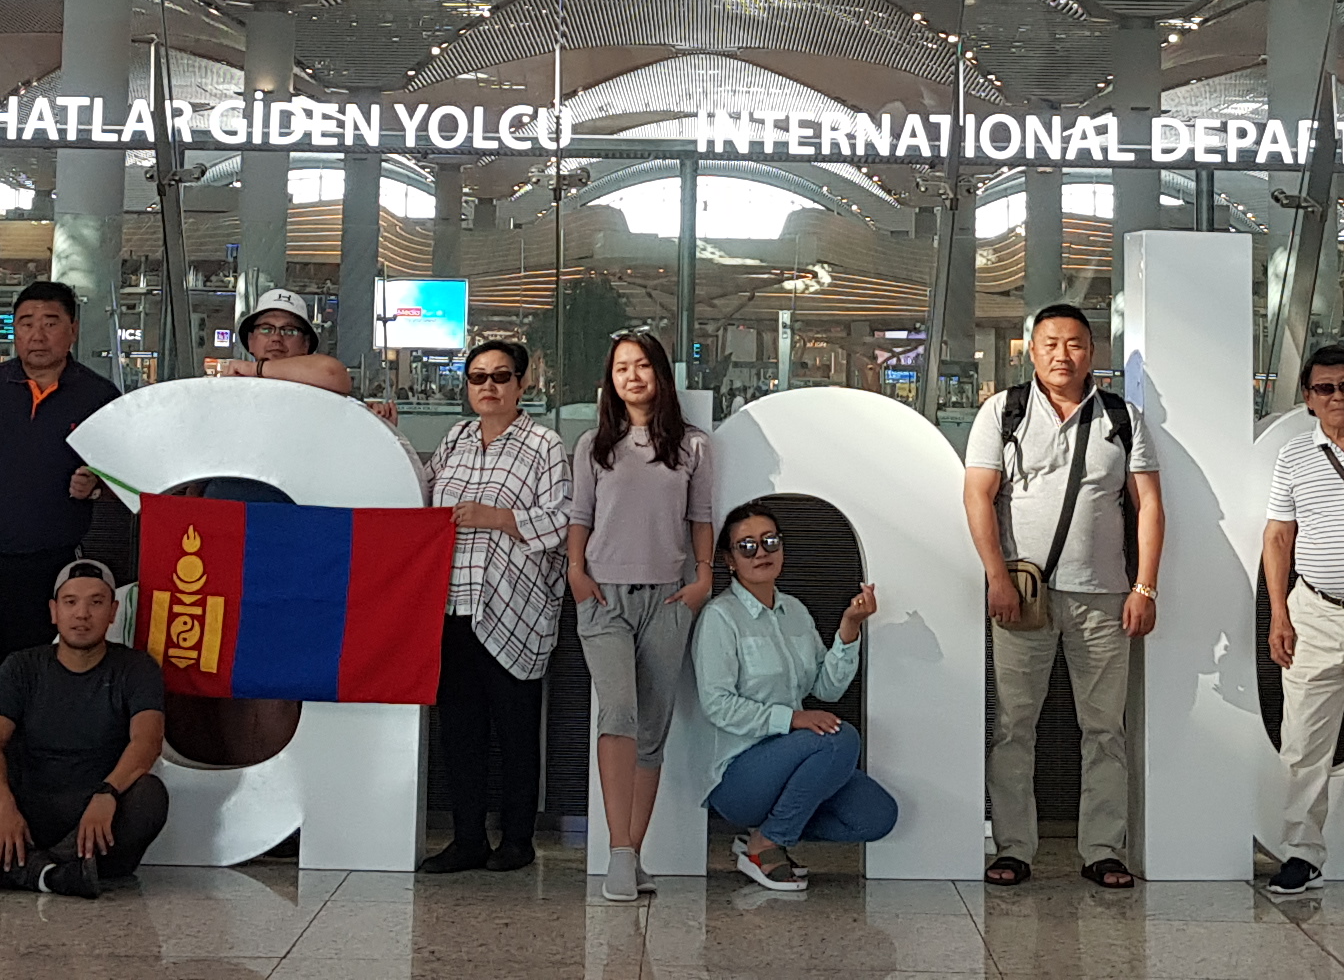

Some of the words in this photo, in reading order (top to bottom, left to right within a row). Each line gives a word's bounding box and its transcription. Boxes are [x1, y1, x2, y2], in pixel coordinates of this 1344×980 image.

[209, 90, 380, 147] GİDEN
[393, 103, 572, 150] YOLCU
[696, 109, 1136, 161] INTERNATIONAL
